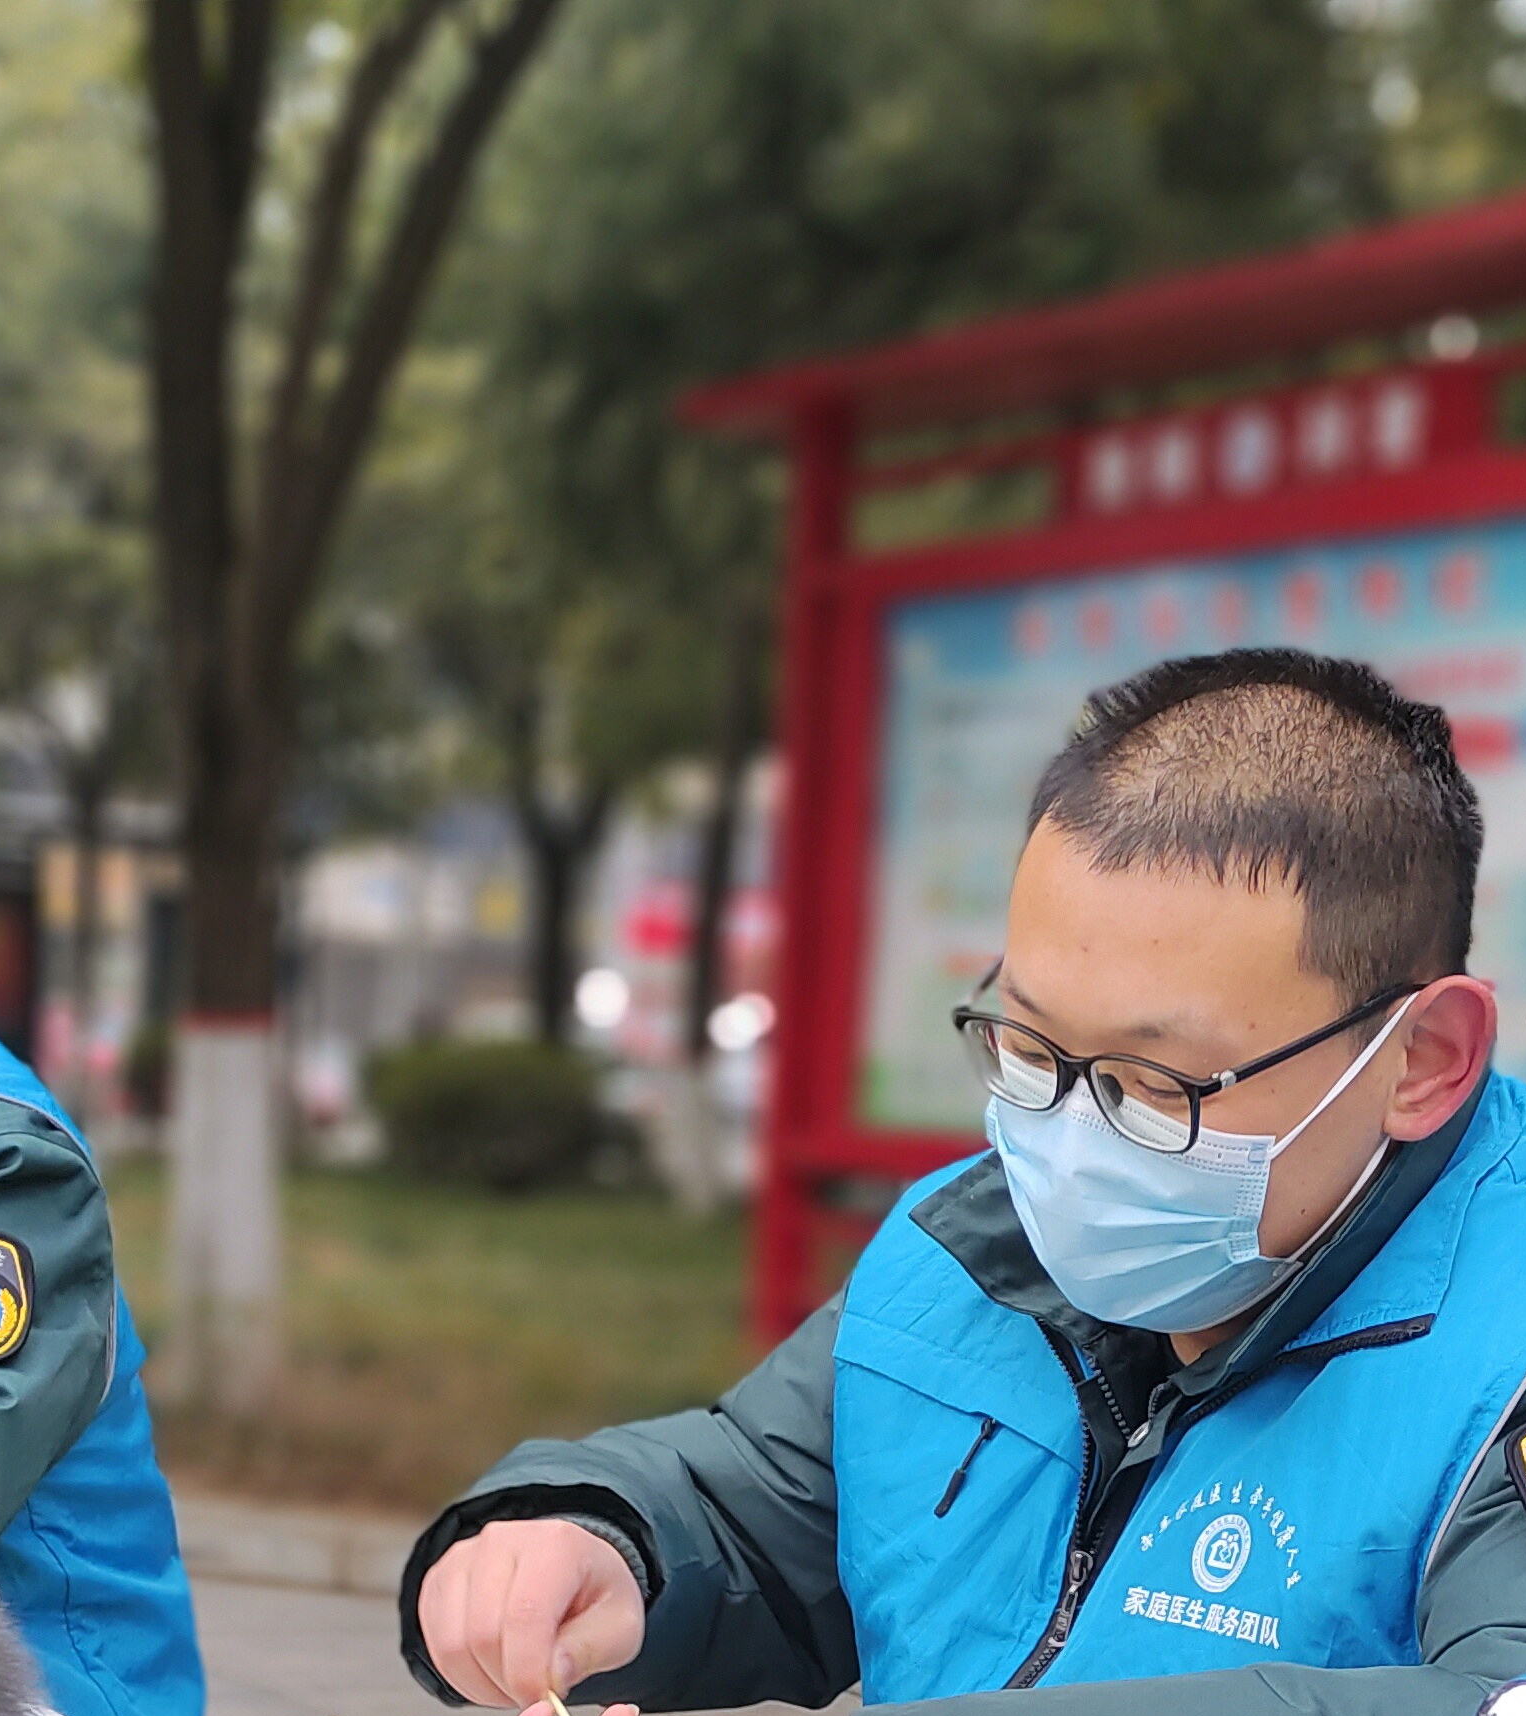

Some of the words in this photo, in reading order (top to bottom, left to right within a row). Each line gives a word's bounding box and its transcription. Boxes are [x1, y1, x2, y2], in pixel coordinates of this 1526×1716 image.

[1123, 1585, 1282, 1650] 家庭医生服务团队
